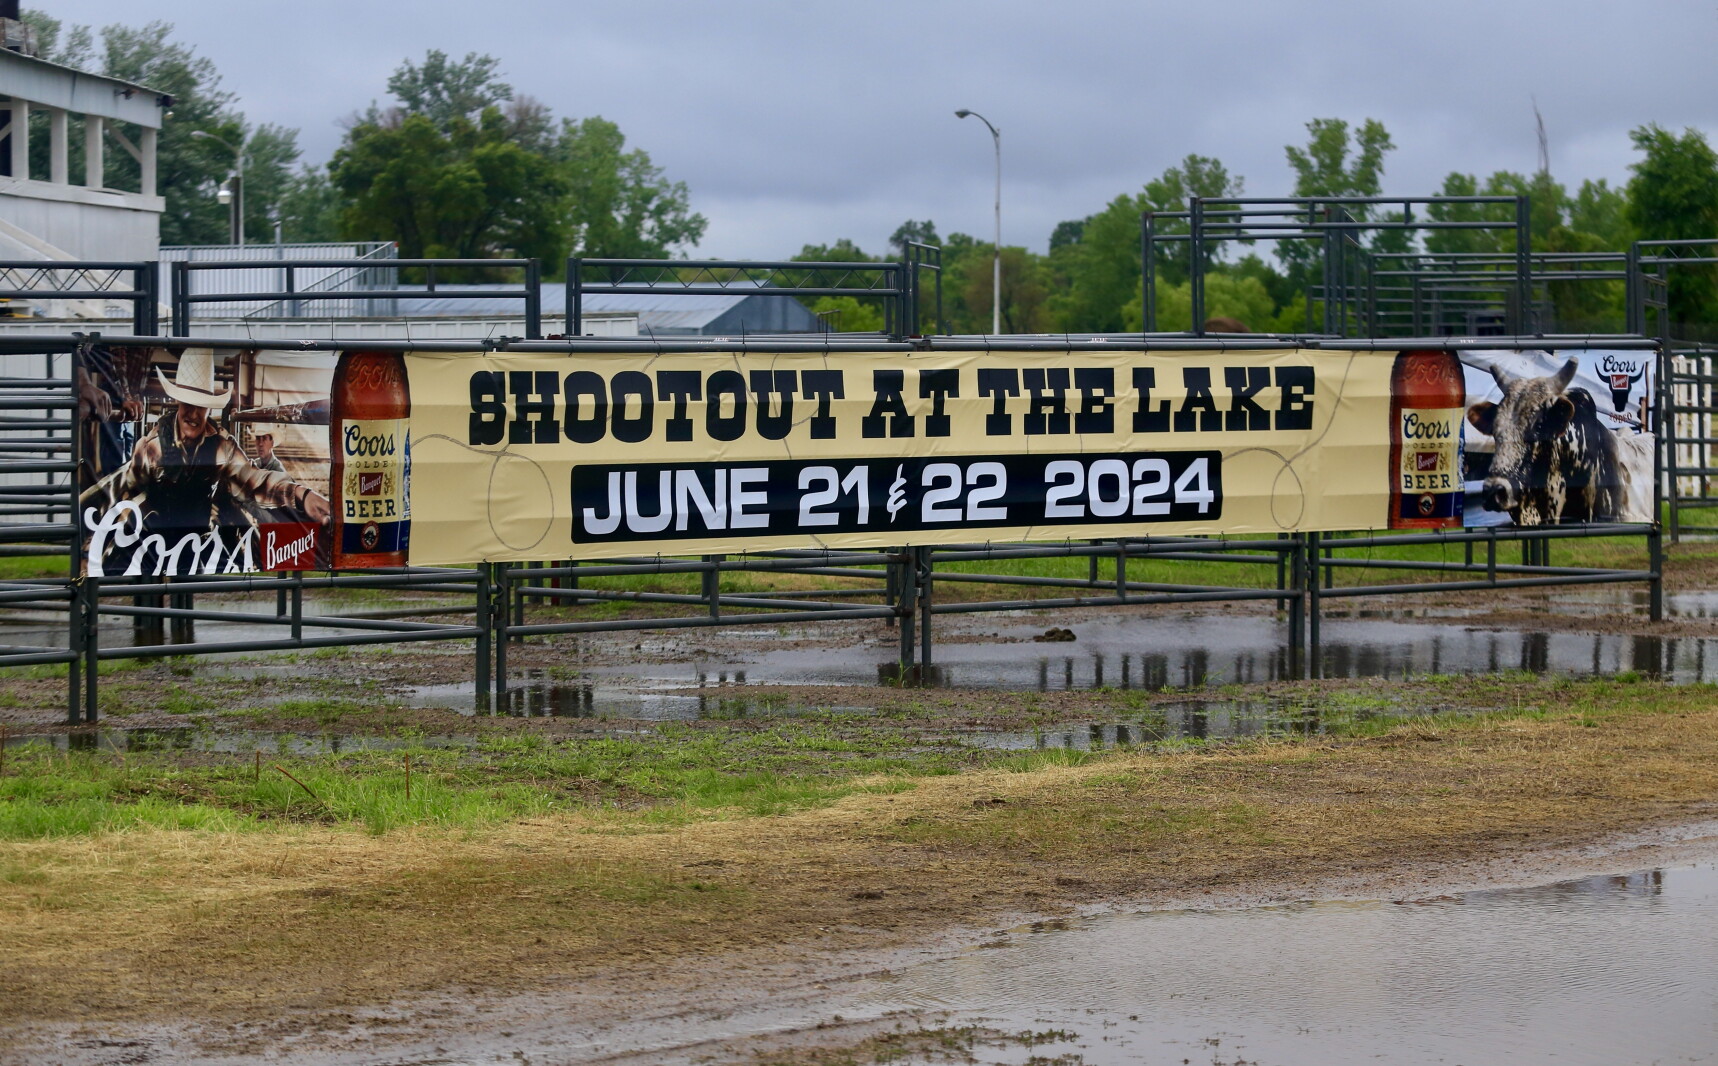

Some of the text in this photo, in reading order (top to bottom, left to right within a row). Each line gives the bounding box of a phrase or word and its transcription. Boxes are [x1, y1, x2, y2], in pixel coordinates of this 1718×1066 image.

[1603, 355, 1636, 373] Coors
[469, 366, 1315, 446] SHOOTOUT AT THE LAKE
[344, 424, 395, 456] Coors
[1403, 413, 1451, 439] Coors
[583, 457, 1215, 535] JUNE 21 & 22 2024
[1404, 474, 1451, 489] BEER
[345, 499, 396, 518] BEER
[266, 528, 315, 570] Banquet
